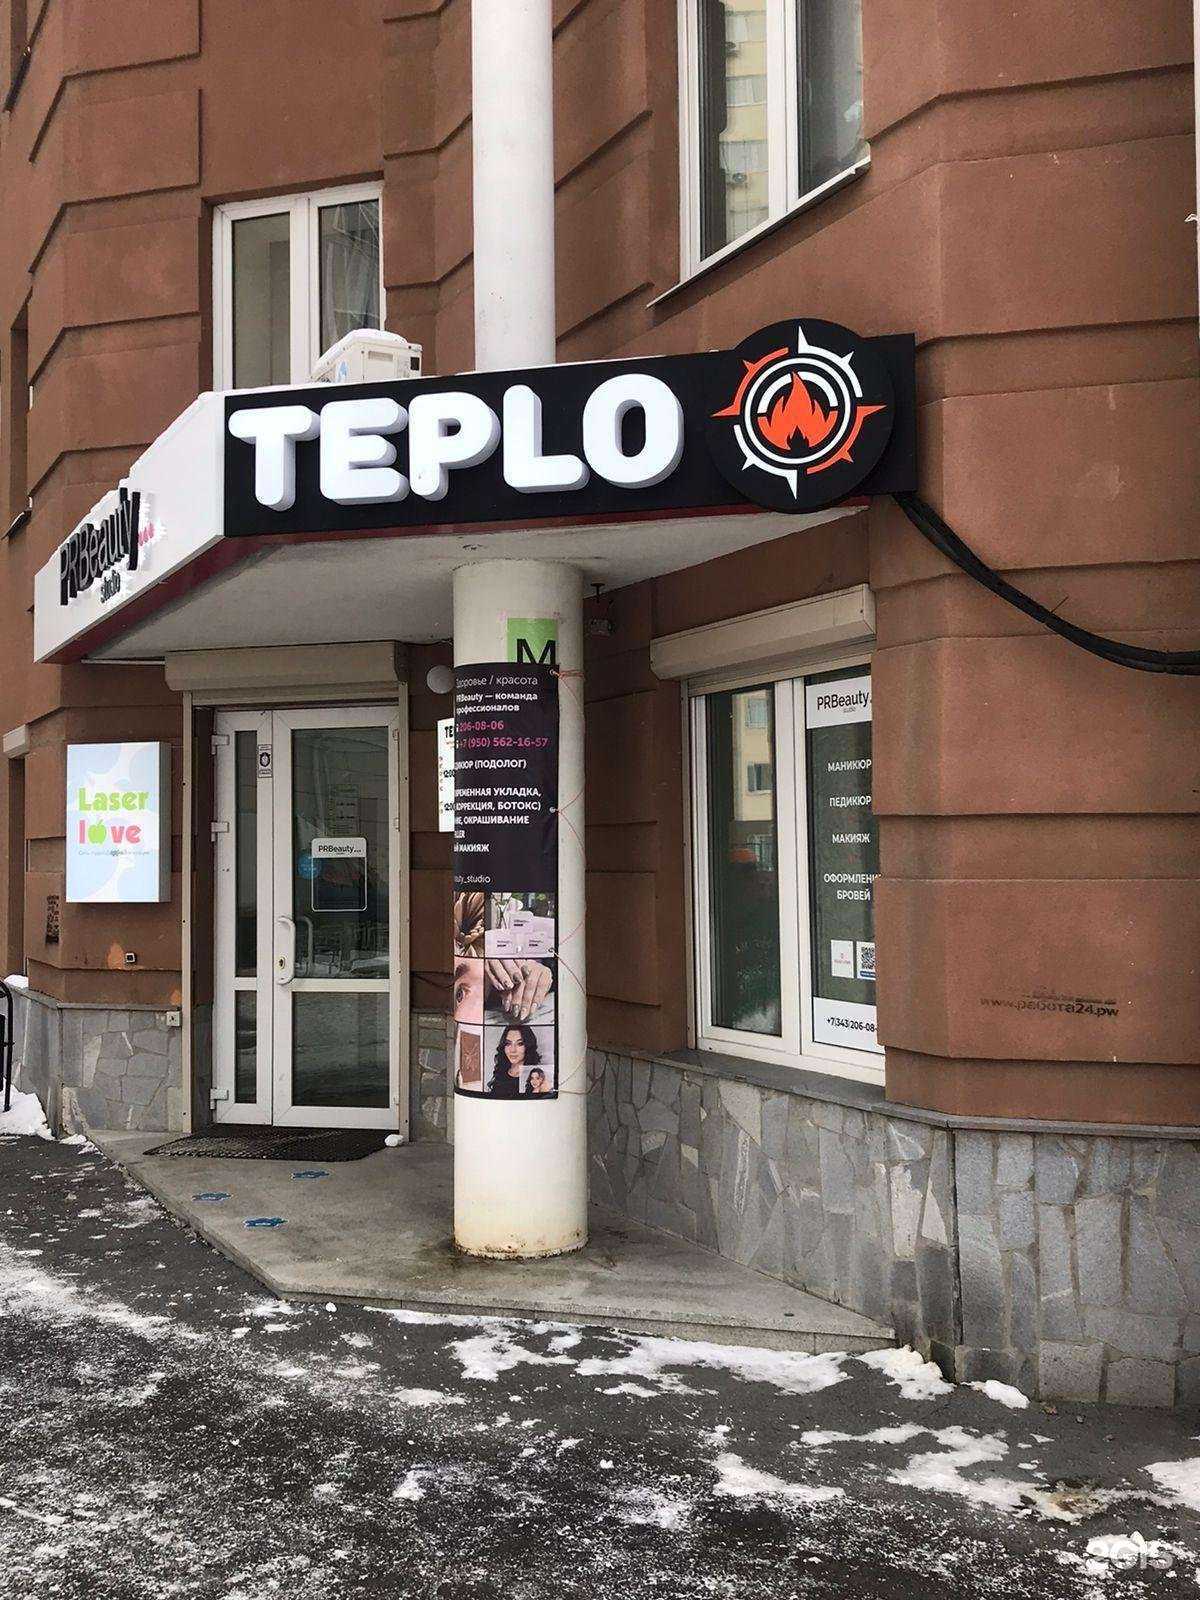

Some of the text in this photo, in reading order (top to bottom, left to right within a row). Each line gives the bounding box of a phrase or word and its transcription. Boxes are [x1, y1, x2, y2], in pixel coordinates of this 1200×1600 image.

[228, 373, 685, 511] TEPLO
[496, 676, 538, 687] красота
[495, 692, 538, 701] команда
[456, 704, 520, 715] рофессионалов
[493, 737, 548, 747] 562-16-57
[475, 759, 527, 769] (ПОДОЛОГ)
[828, 758, 872, 772] МАНИКЮР
[493, 787, 541, 797] УКЛАДКА,
[78, 787, 149, 812] Laser
[829, 795, 872, 808] ПЕДИКЮР
[497, 801, 541, 811] БОТОКС)
[464, 815, 530, 825] ОКРАШИВАНИЕ
[832, 833, 871, 845] МАКИЯЖ
[823, 873, 882, 884] ОФОРМЛЕНИ
[836, 888, 871, 901] БРОВЕЙ
